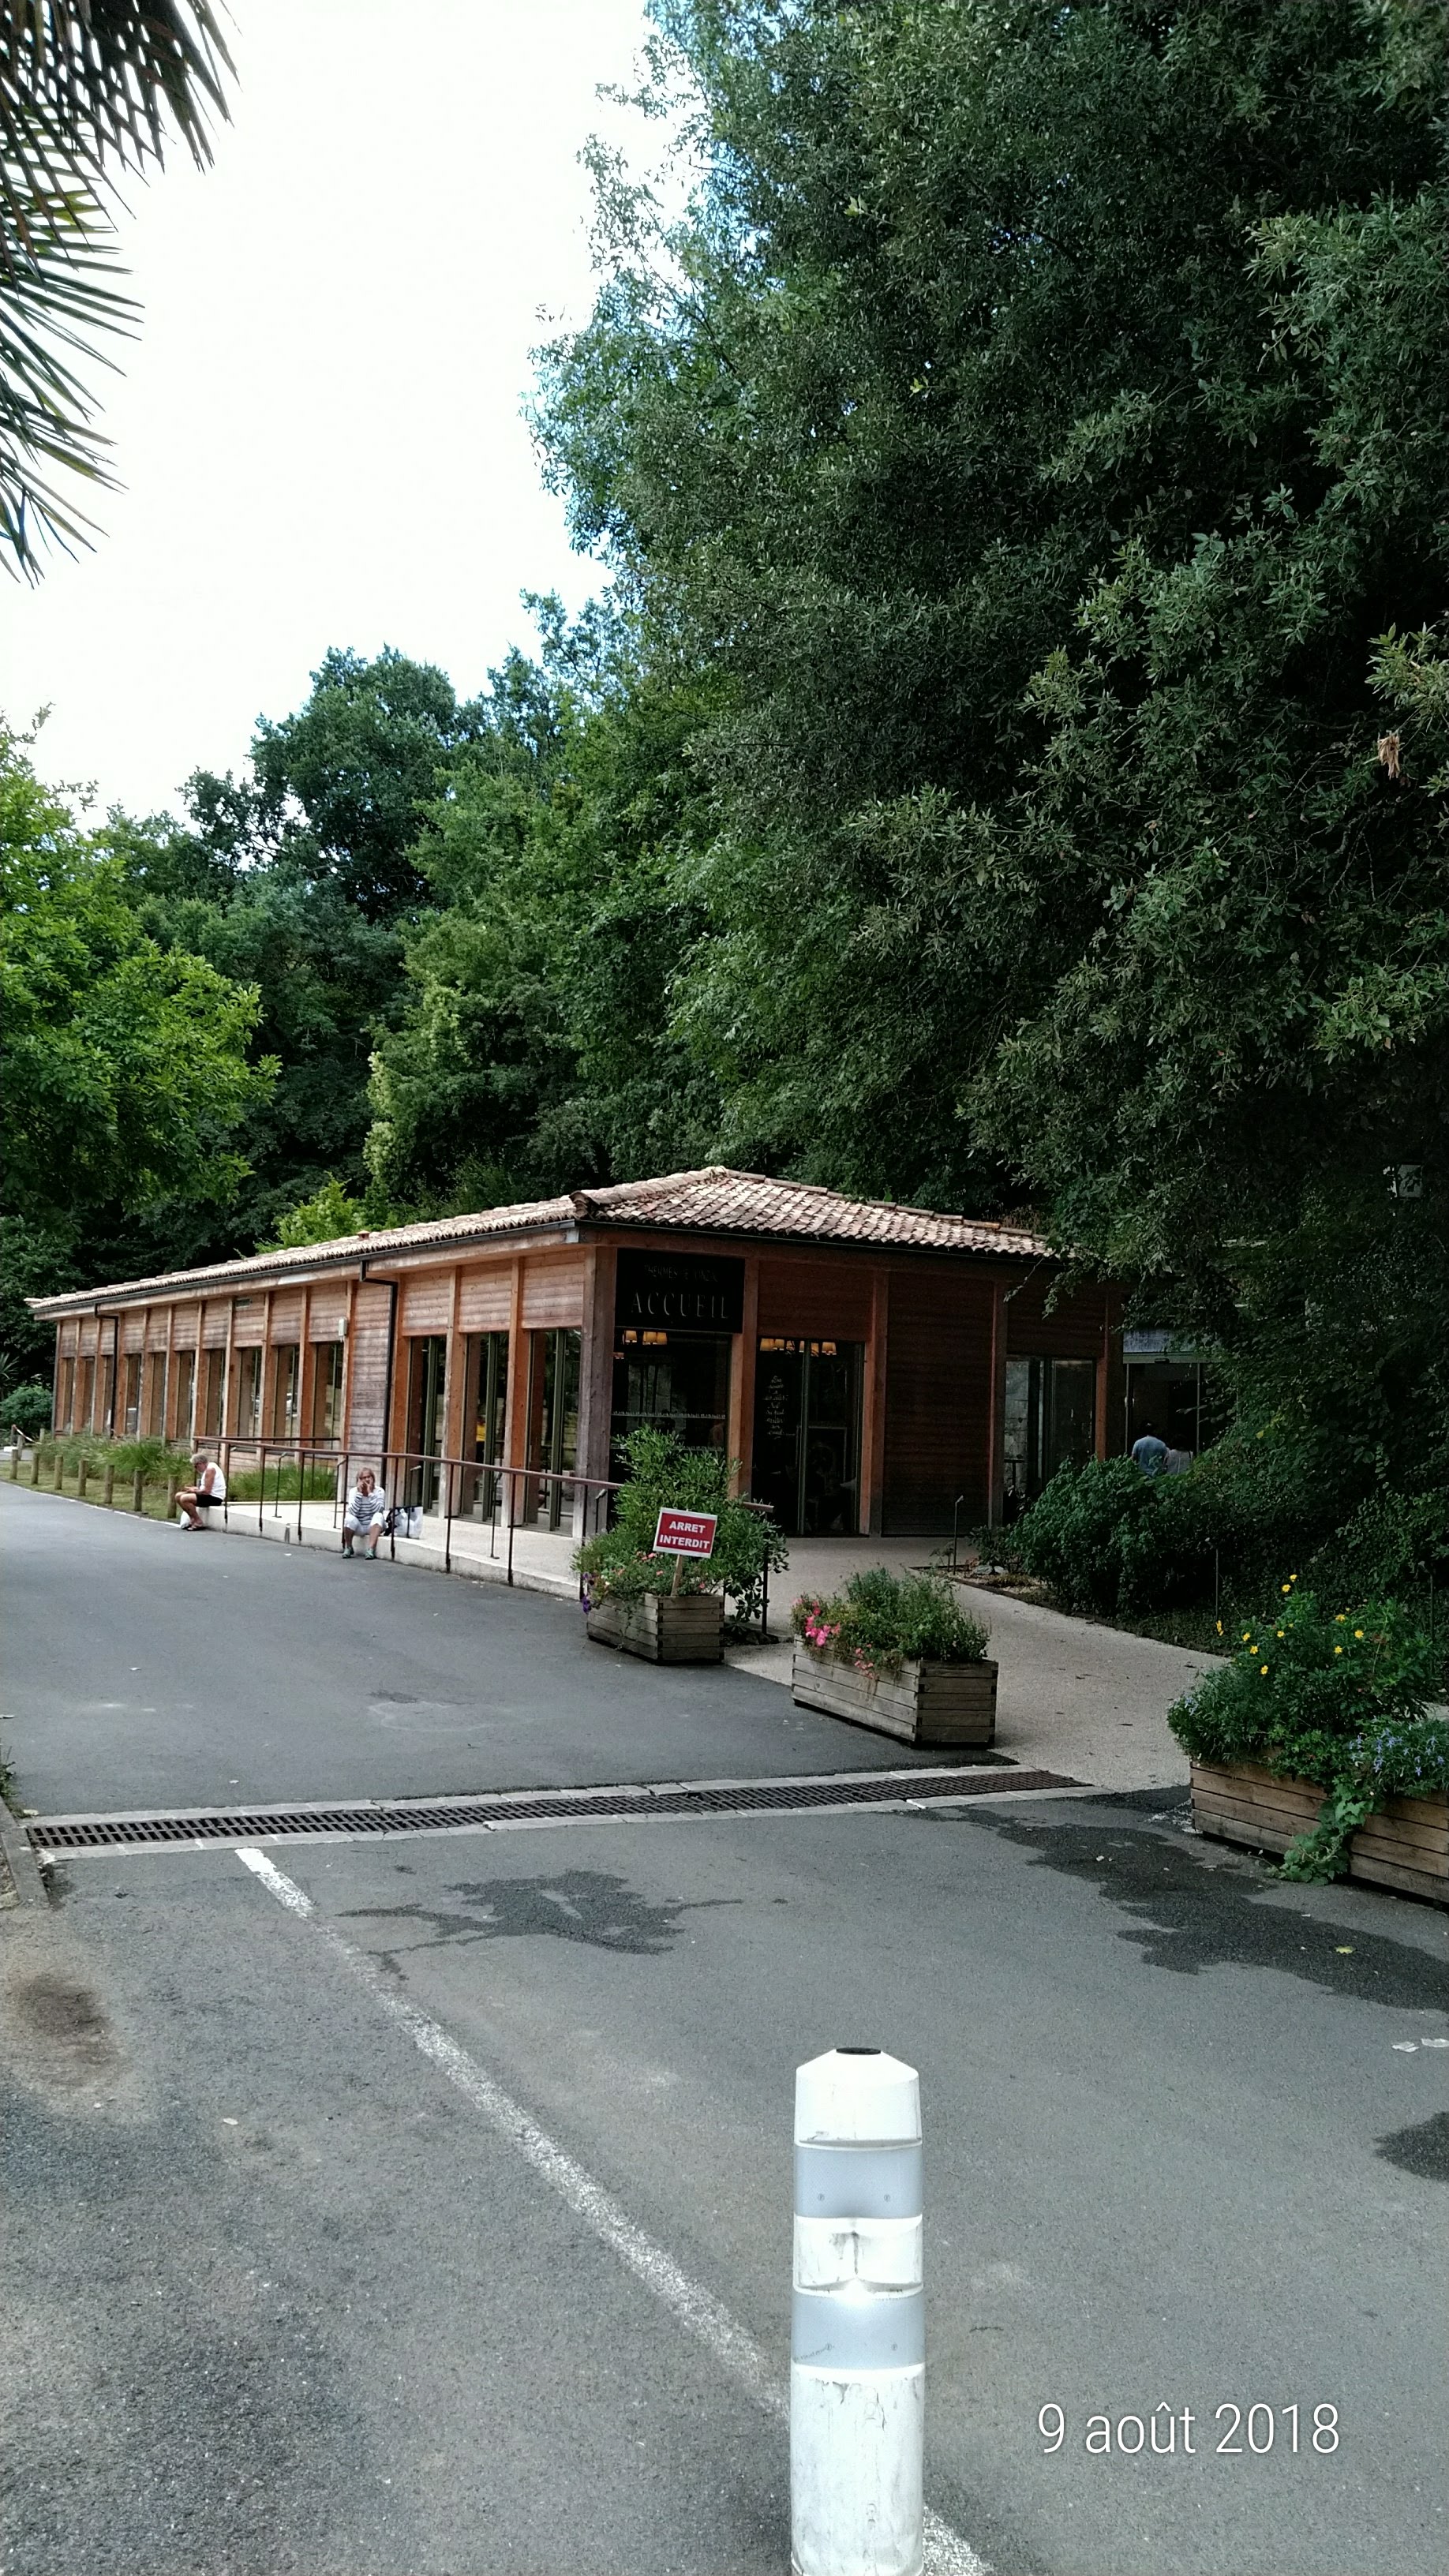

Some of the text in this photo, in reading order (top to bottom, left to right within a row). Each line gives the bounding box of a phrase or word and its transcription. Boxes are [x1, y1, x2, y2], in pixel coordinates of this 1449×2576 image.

[631, 1291, 728, 1319] ACCUEIL
[668, 1521, 706, 1533] ARRET
[659, 1534, 710, 1549] INTERDIT
